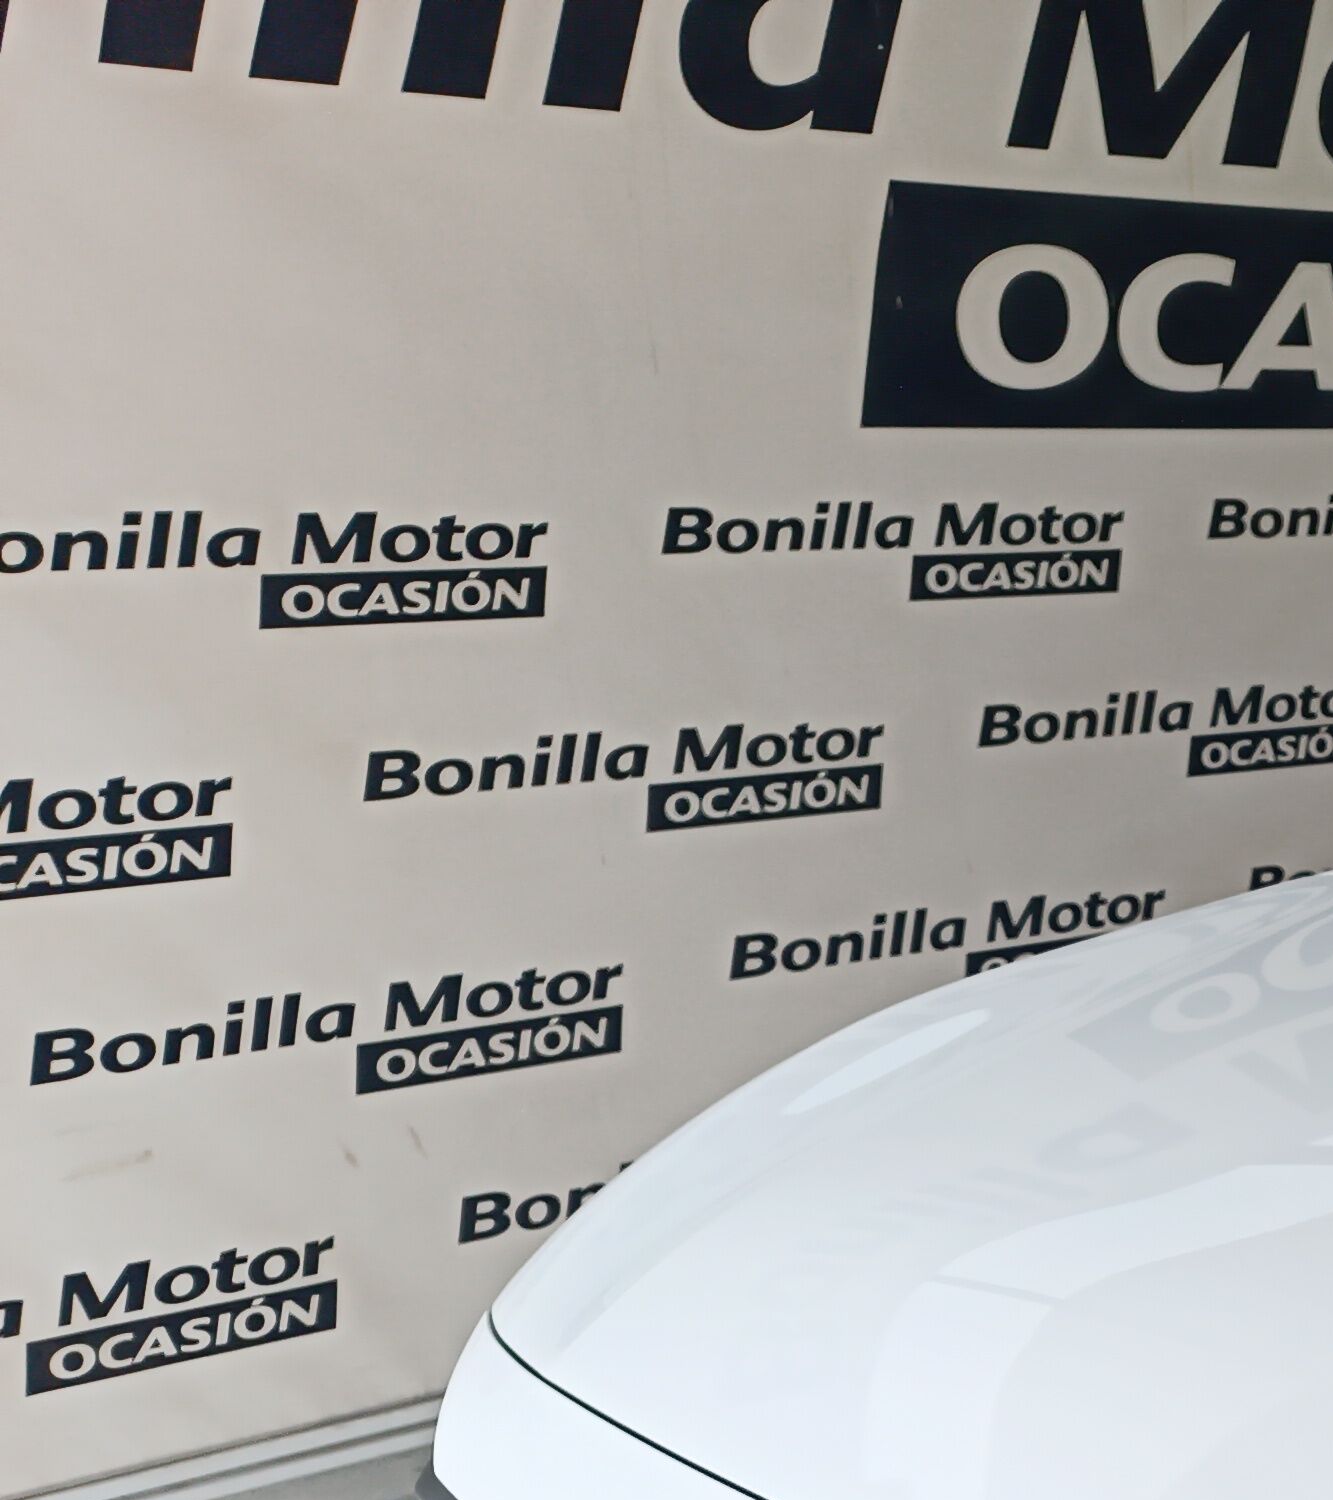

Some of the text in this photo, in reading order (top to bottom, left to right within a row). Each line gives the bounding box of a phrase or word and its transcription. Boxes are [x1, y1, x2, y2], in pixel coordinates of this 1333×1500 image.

[291, 511, 549, 565] Motor
[661, 501, 1125, 555] Bonilla Motor
[280, 571, 531, 621] OCASIÓN
[924, 554, 1110, 594] OCASIÓN
[978, 689, 1193, 749] Bonilla
[363, 722, 885, 802] Bonilla Motor
[661, 768, 871, 824] OCASIÓN
[729, 889, 1166, 980] Bonilla Motor
[29, 963, 624, 1086] Bonilla Motor
[374, 1018, 611, 1083] OCASIÓN
[58, 1235, 335, 1328] Motor
[49, 1293, 320, 1381] OCASIÓN
